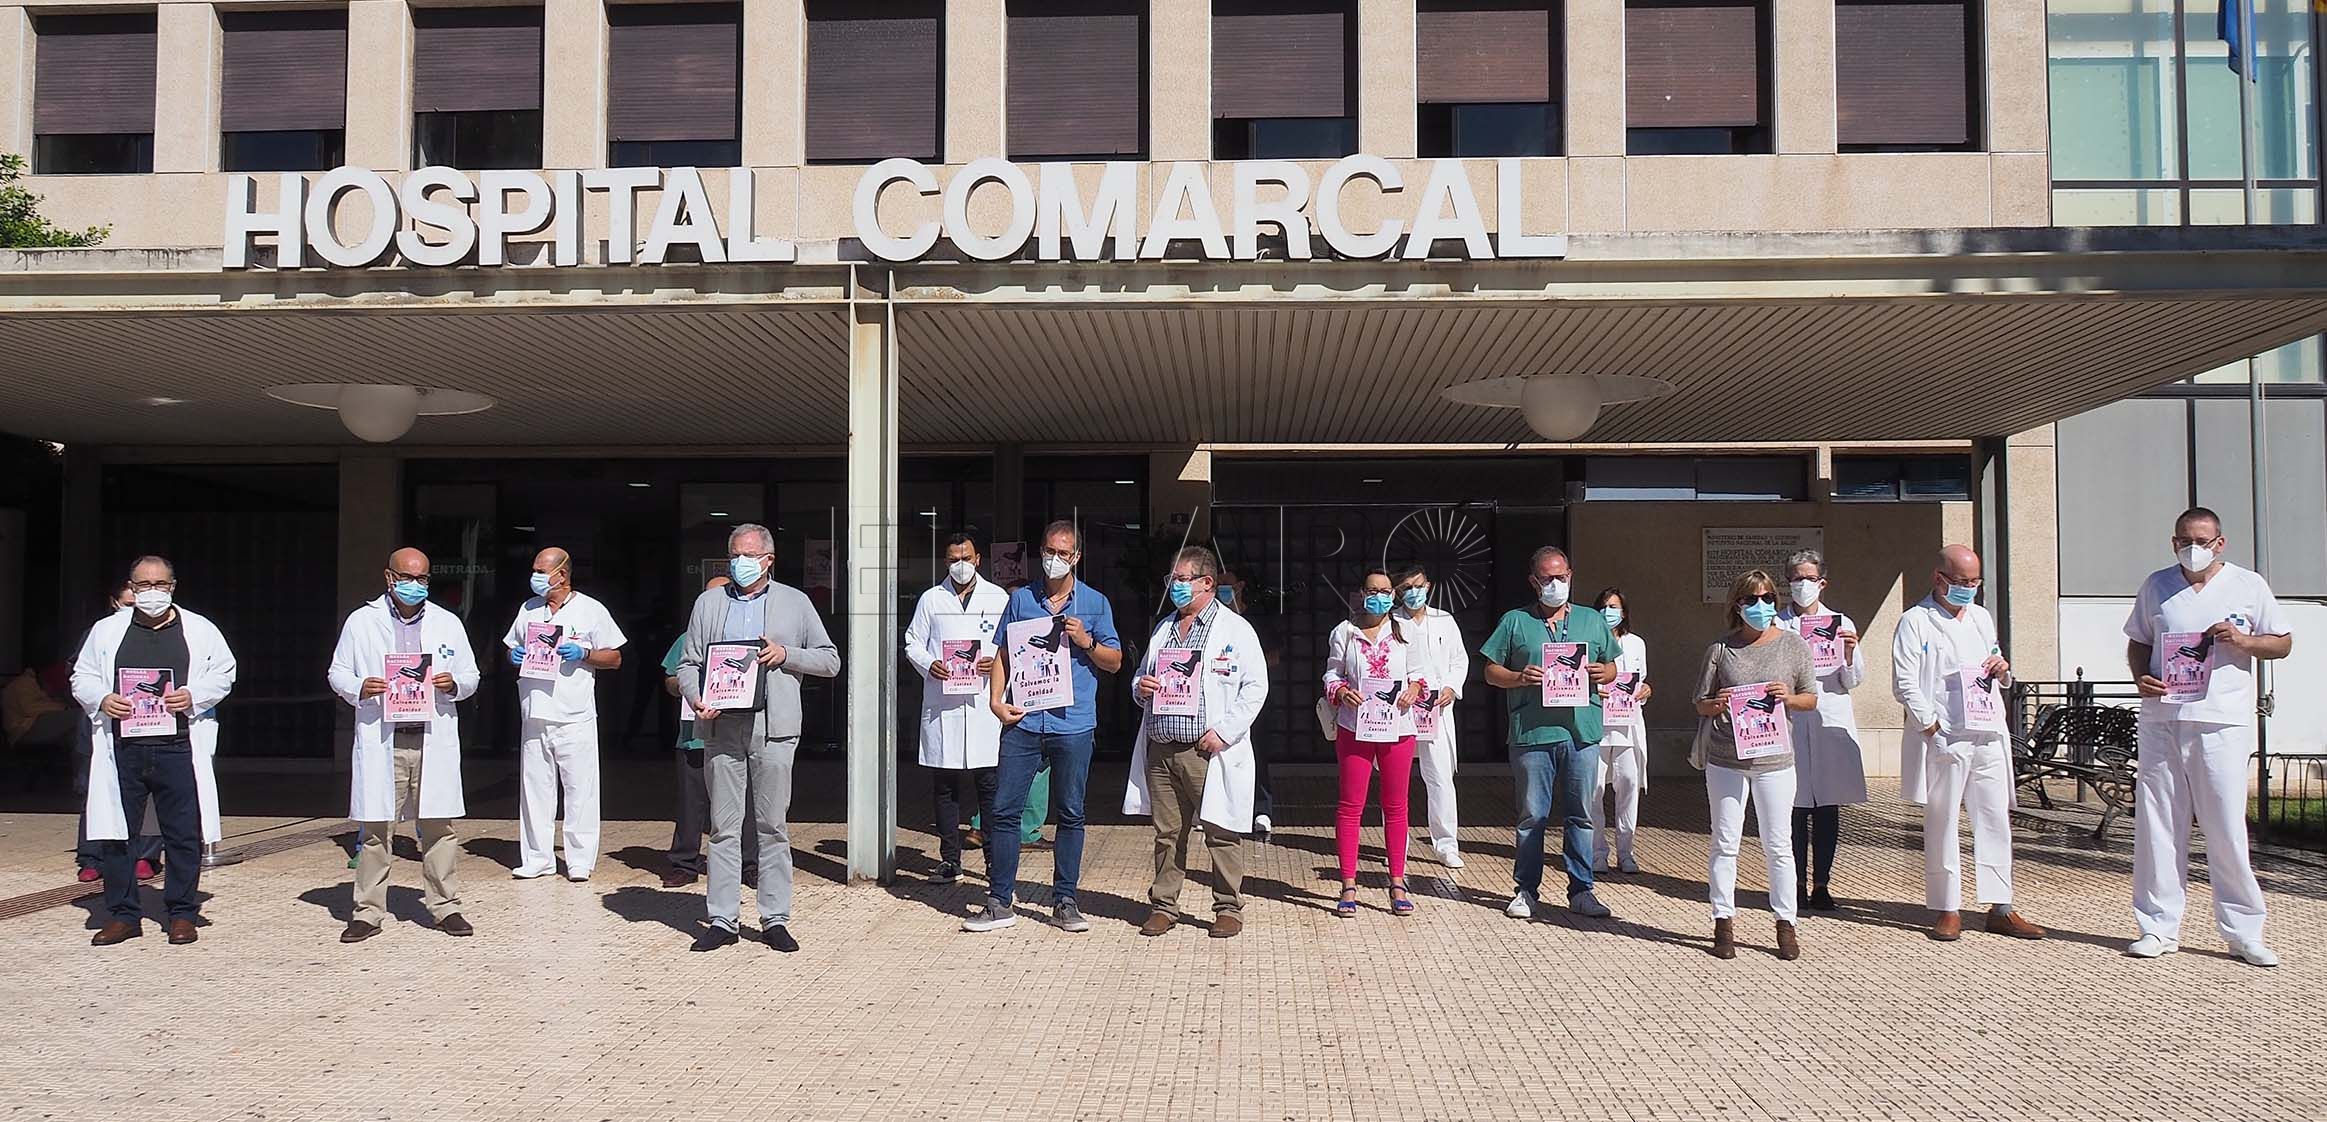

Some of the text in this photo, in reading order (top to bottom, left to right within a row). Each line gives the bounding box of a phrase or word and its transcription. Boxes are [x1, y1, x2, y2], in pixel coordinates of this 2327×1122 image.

[223, 154, 1568, 268] HOSPITAL COMARCAL
[432, 564, 488, 574] ENTRADA
[1020, 678, 1050, 688] Salvemos
[1028, 688, 1054, 697] Sanidad
